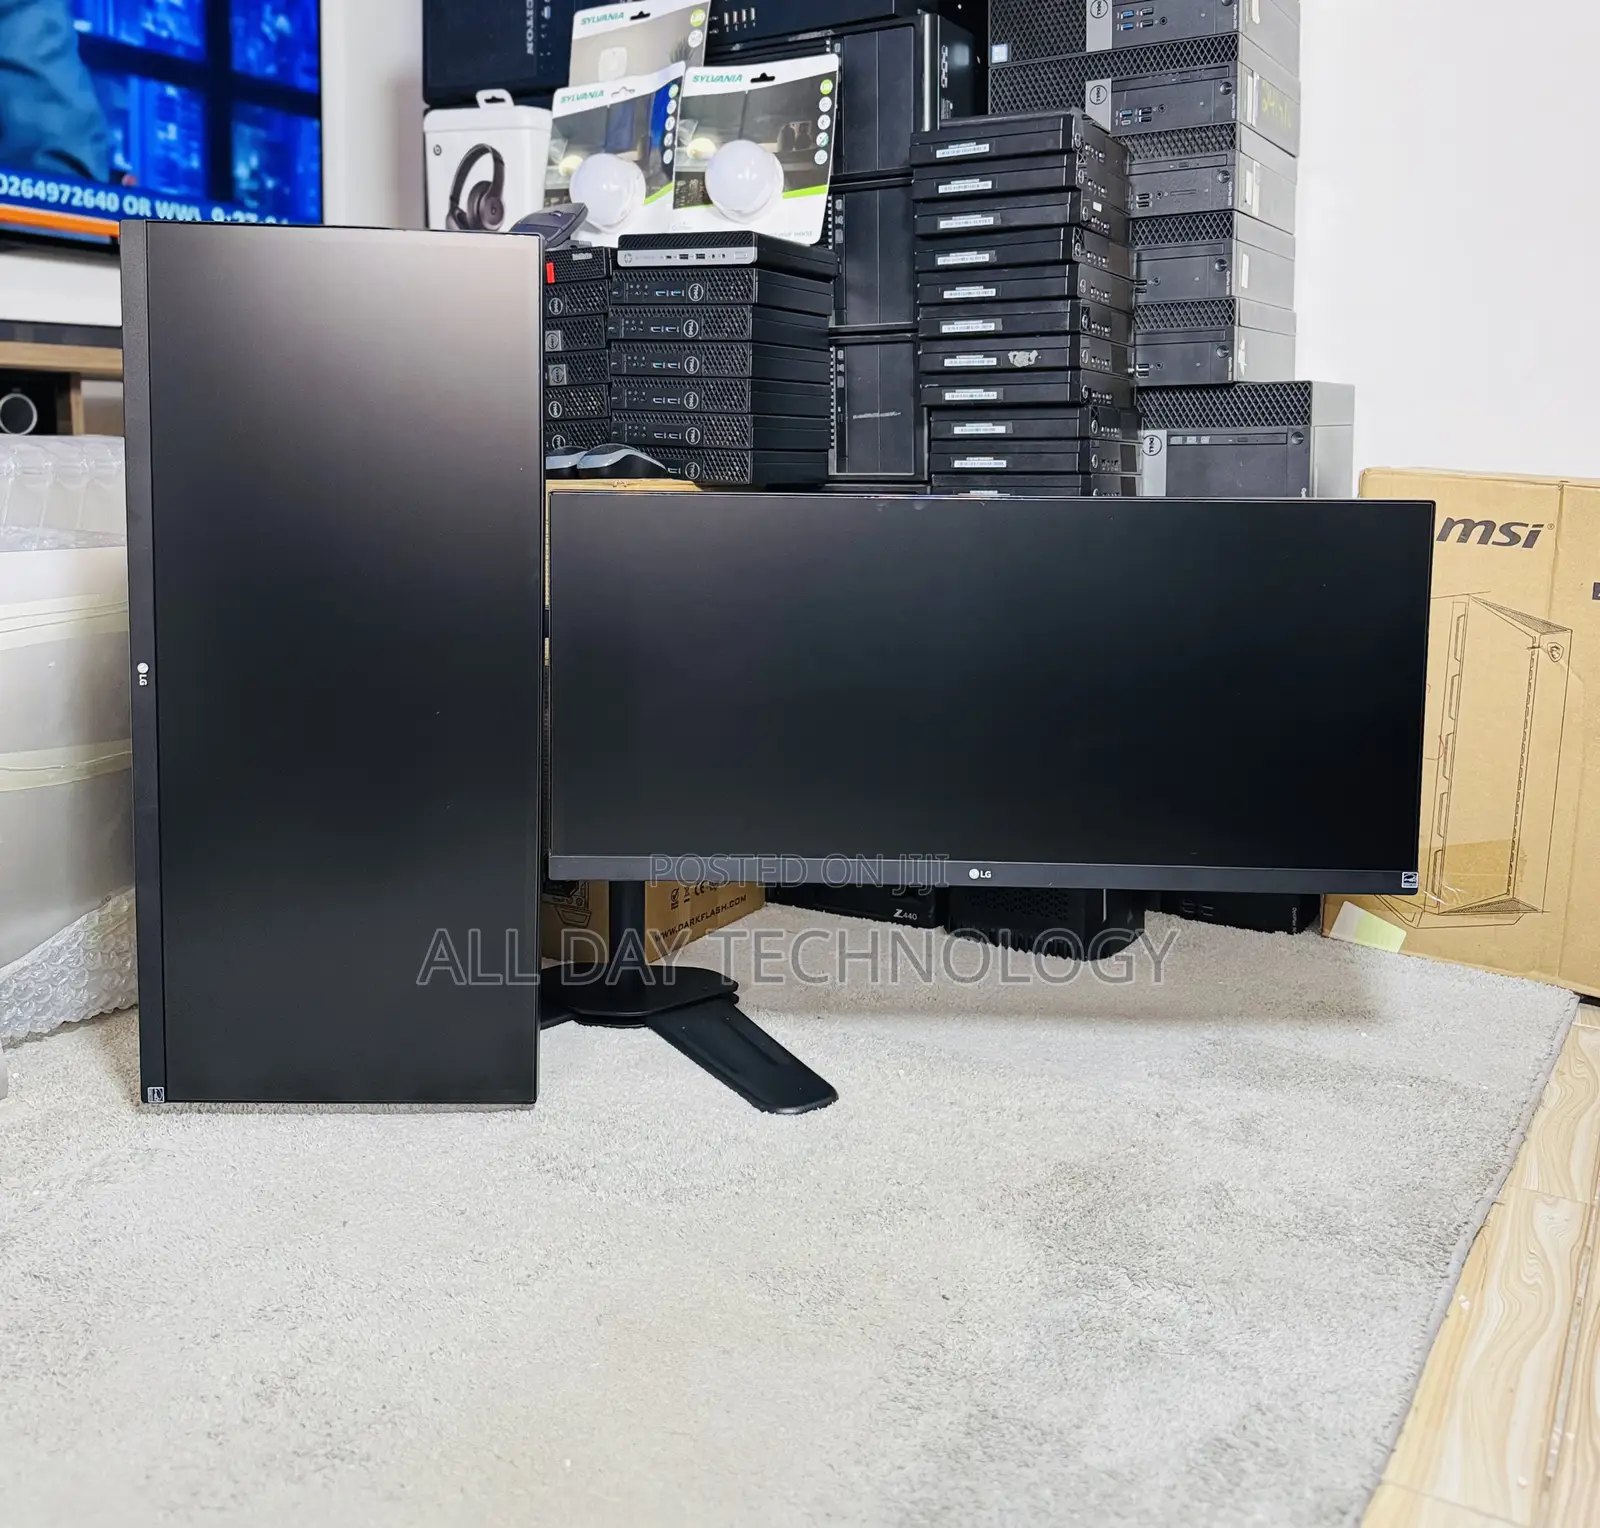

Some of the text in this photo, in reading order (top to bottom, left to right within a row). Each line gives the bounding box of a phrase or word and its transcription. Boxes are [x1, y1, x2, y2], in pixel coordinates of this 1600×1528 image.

[580, 12, 625, 26] SYLVANIA
[692, 74, 743, 83] SYLVANIA
[560, 90, 605, 104] SYLVANIA
[122, 194, 151, 217] OR
[1436, 517, 1544, 548] msi
[654, 894, 747, 942] WWW.DARKFLASH.COM
[893, 908, 918, 920] Z440
